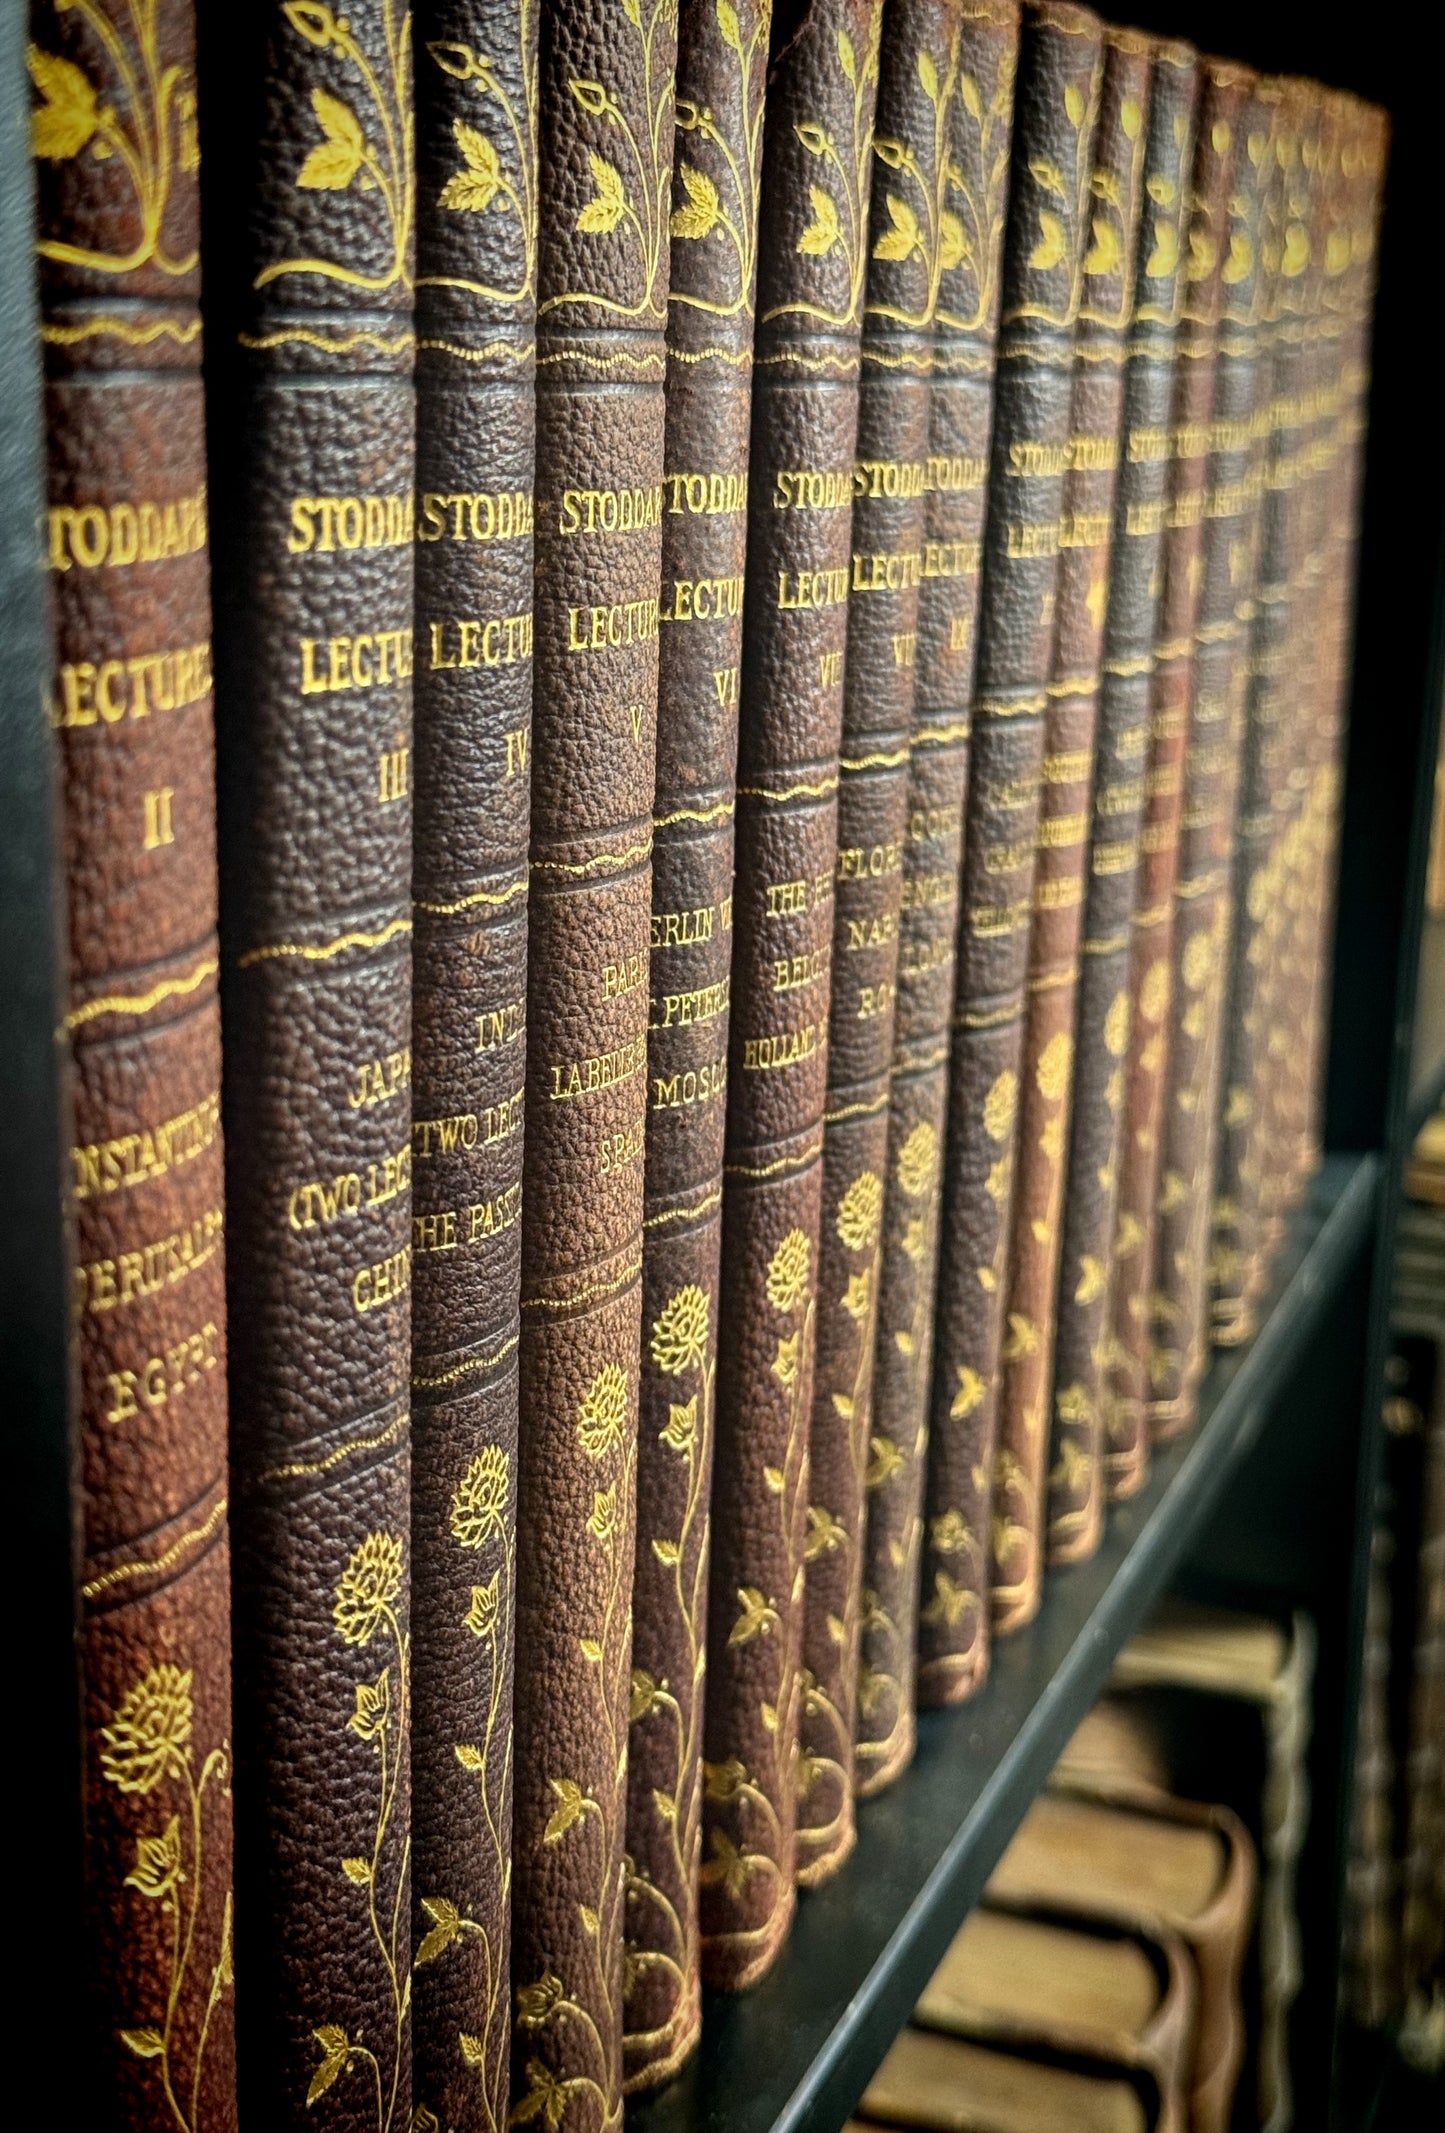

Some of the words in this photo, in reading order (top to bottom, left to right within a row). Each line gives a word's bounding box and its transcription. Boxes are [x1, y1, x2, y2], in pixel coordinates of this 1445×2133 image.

[713, 667, 738, 706] VI
[630, 704, 643, 743] V
[500, 729, 528, 777] IV
[378, 749, 409, 802] III
[144, 786, 175, 849] II
[766, 879, 806, 918] THE
[651, 905, 715, 948] ERLIN
